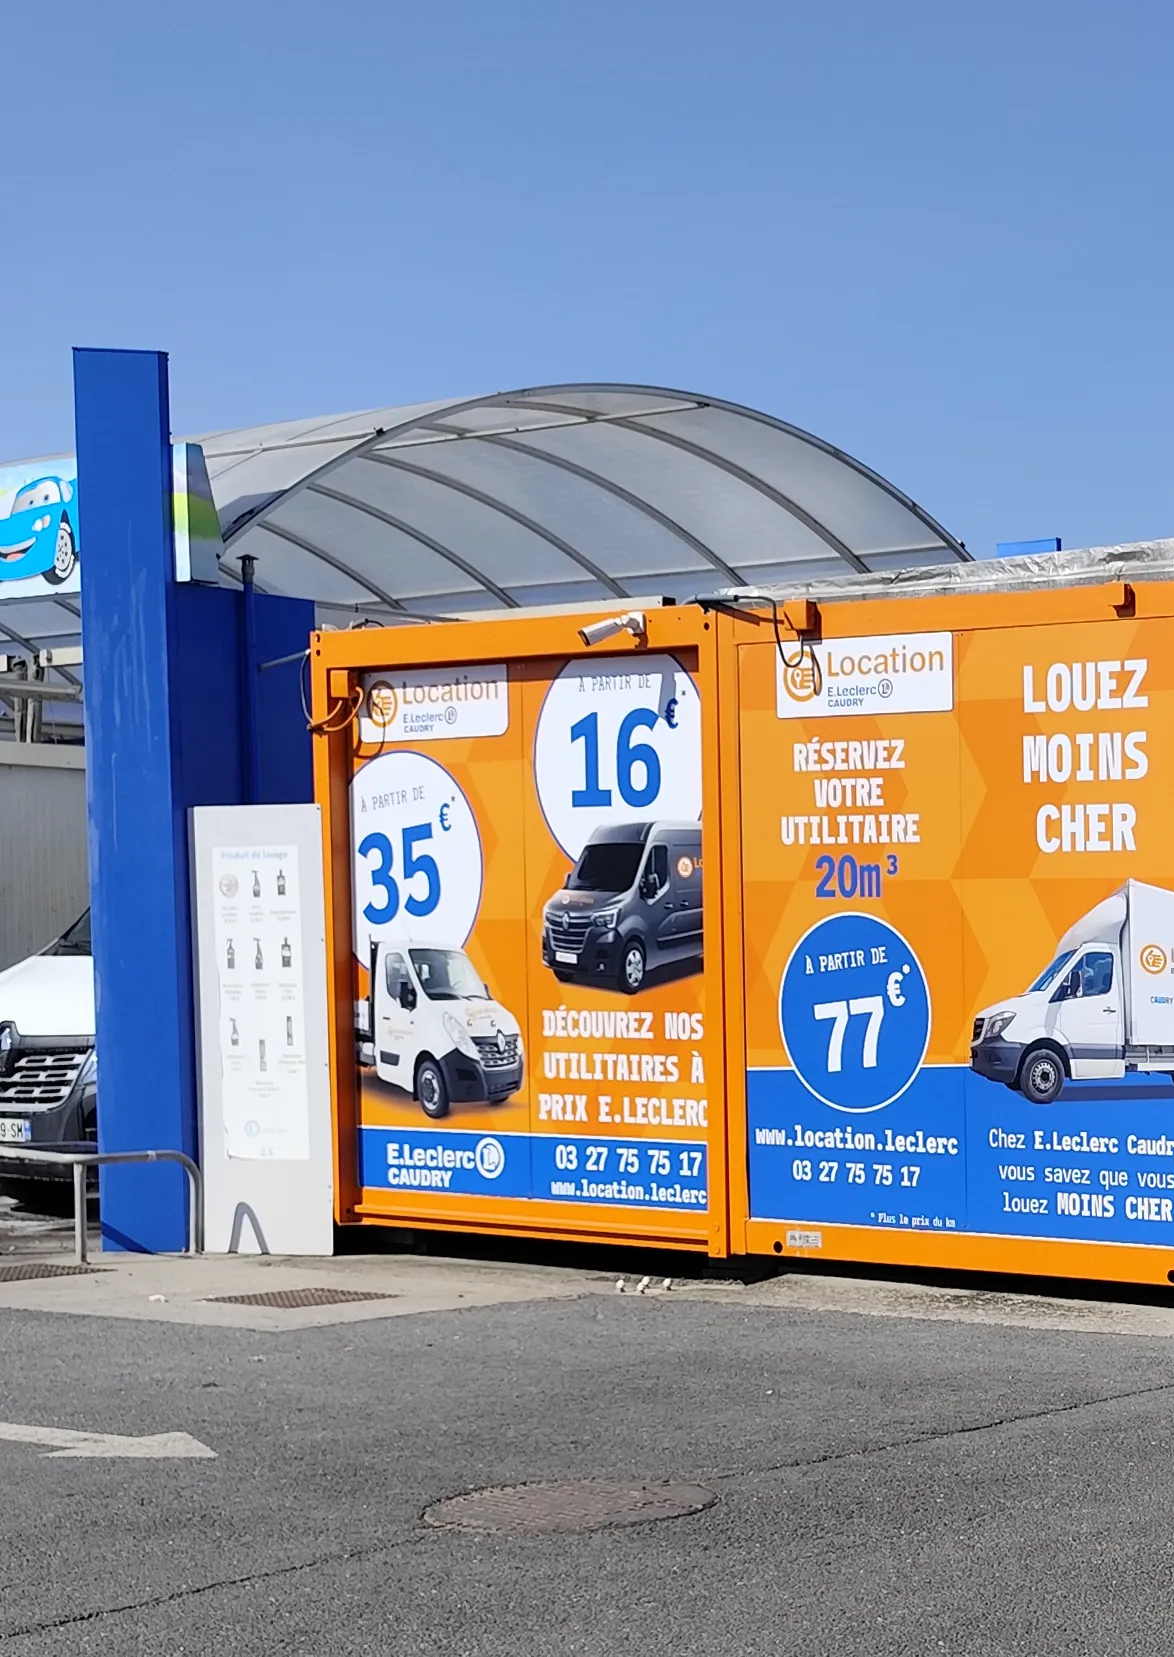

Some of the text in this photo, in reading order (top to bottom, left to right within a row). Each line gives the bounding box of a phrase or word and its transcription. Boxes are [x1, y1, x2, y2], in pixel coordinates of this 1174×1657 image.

[827, 645, 944, 677] Location
[402, 675, 499, 704] Location
[592, 673, 632, 691] PARTIR
[638, 671, 652, 688] DE
[827, 685, 877, 697] E.Leclerc
[1022, 659, 1149, 713] LOUEZ
[828, 698, 864, 708] CAUDRY
[403, 713, 444, 724] E.Leclerc
[404, 725, 434, 734] CAUDRY
[793, 736, 906, 773] RÉSERVEZ
[1022, 731, 1149, 784] MOINS
[372, 790, 408, 811] PARTIR
[413, 785, 426, 801] DE
[813, 778, 884, 808] VOTRE
[781, 813, 920, 845] UTILITAIRE
[1036, 803, 1137, 854] CHER
[805, 946, 888, 975] À PARTIR DE
[542, 1005, 704, 1041] DÉCOUVREZ NOS
[543, 1050, 704, 1084] UTILITAIRES À
[538, 1093, 708, 1128] PRIX E.LECLERC
[755, 1125, 959, 1155] www.location.leclerc
[988, 1127, 1026, 1149] Chez
[1033, 1130, 1119, 1153] E.Leclerc
[386, 1142, 476, 1170] E.Leclerc
[555, 1144, 703, 1177] 03 27 75 75 17
[387, 1167, 453, 1188] CAUDRY
[792, 1159, 921, 1187] 03 27 75 75 17
[998, 1164, 1035, 1181] vous
[1044, 1167, 1091, 1185] savez
[1099, 1169, 1129, 1191] que
[551, 1179, 707, 1204] www.location.leclerc
[877, 1212, 896, 1224] Plus
[899, 1213, 909, 1225] le
[911, 1214, 930, 1228] prix
[932, 1216, 943, 1228] du
[1002, 1191, 1173, 1222] louez MOINS CHER
